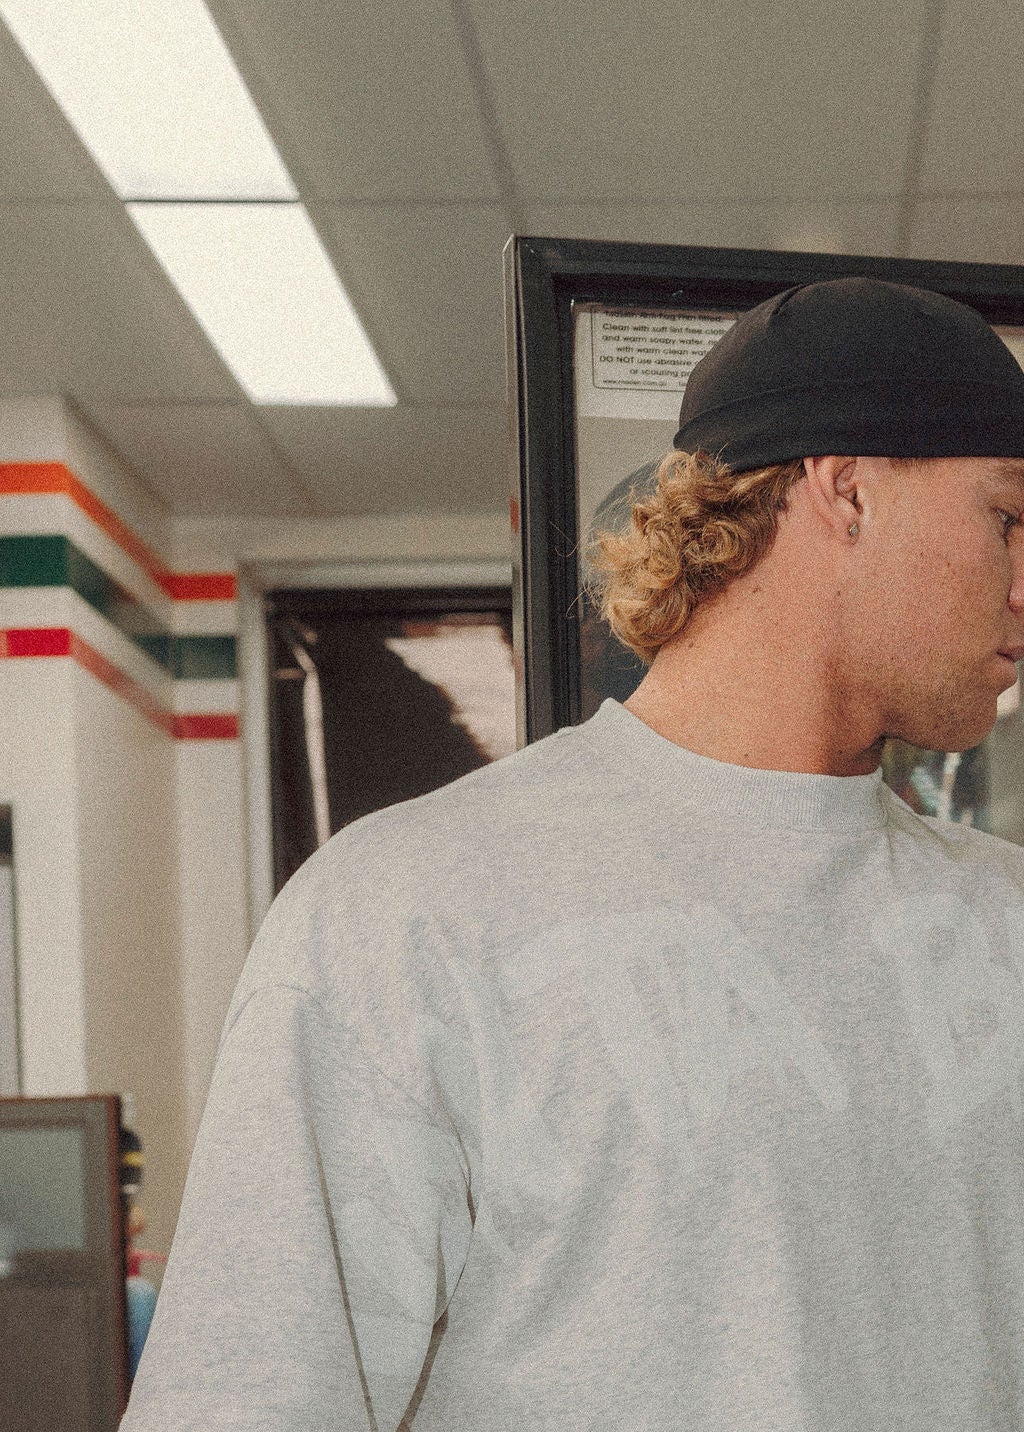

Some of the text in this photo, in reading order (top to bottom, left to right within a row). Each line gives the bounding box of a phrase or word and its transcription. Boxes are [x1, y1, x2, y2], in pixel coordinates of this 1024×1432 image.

[602, 323, 630, 331] Clean
[632, 324, 649, 332] with
[651, 325, 668, 333] soft
[649, 337, 677, 345] soapy
[599, 355, 614, 363] DO
[641, 369, 679, 378] scouring
